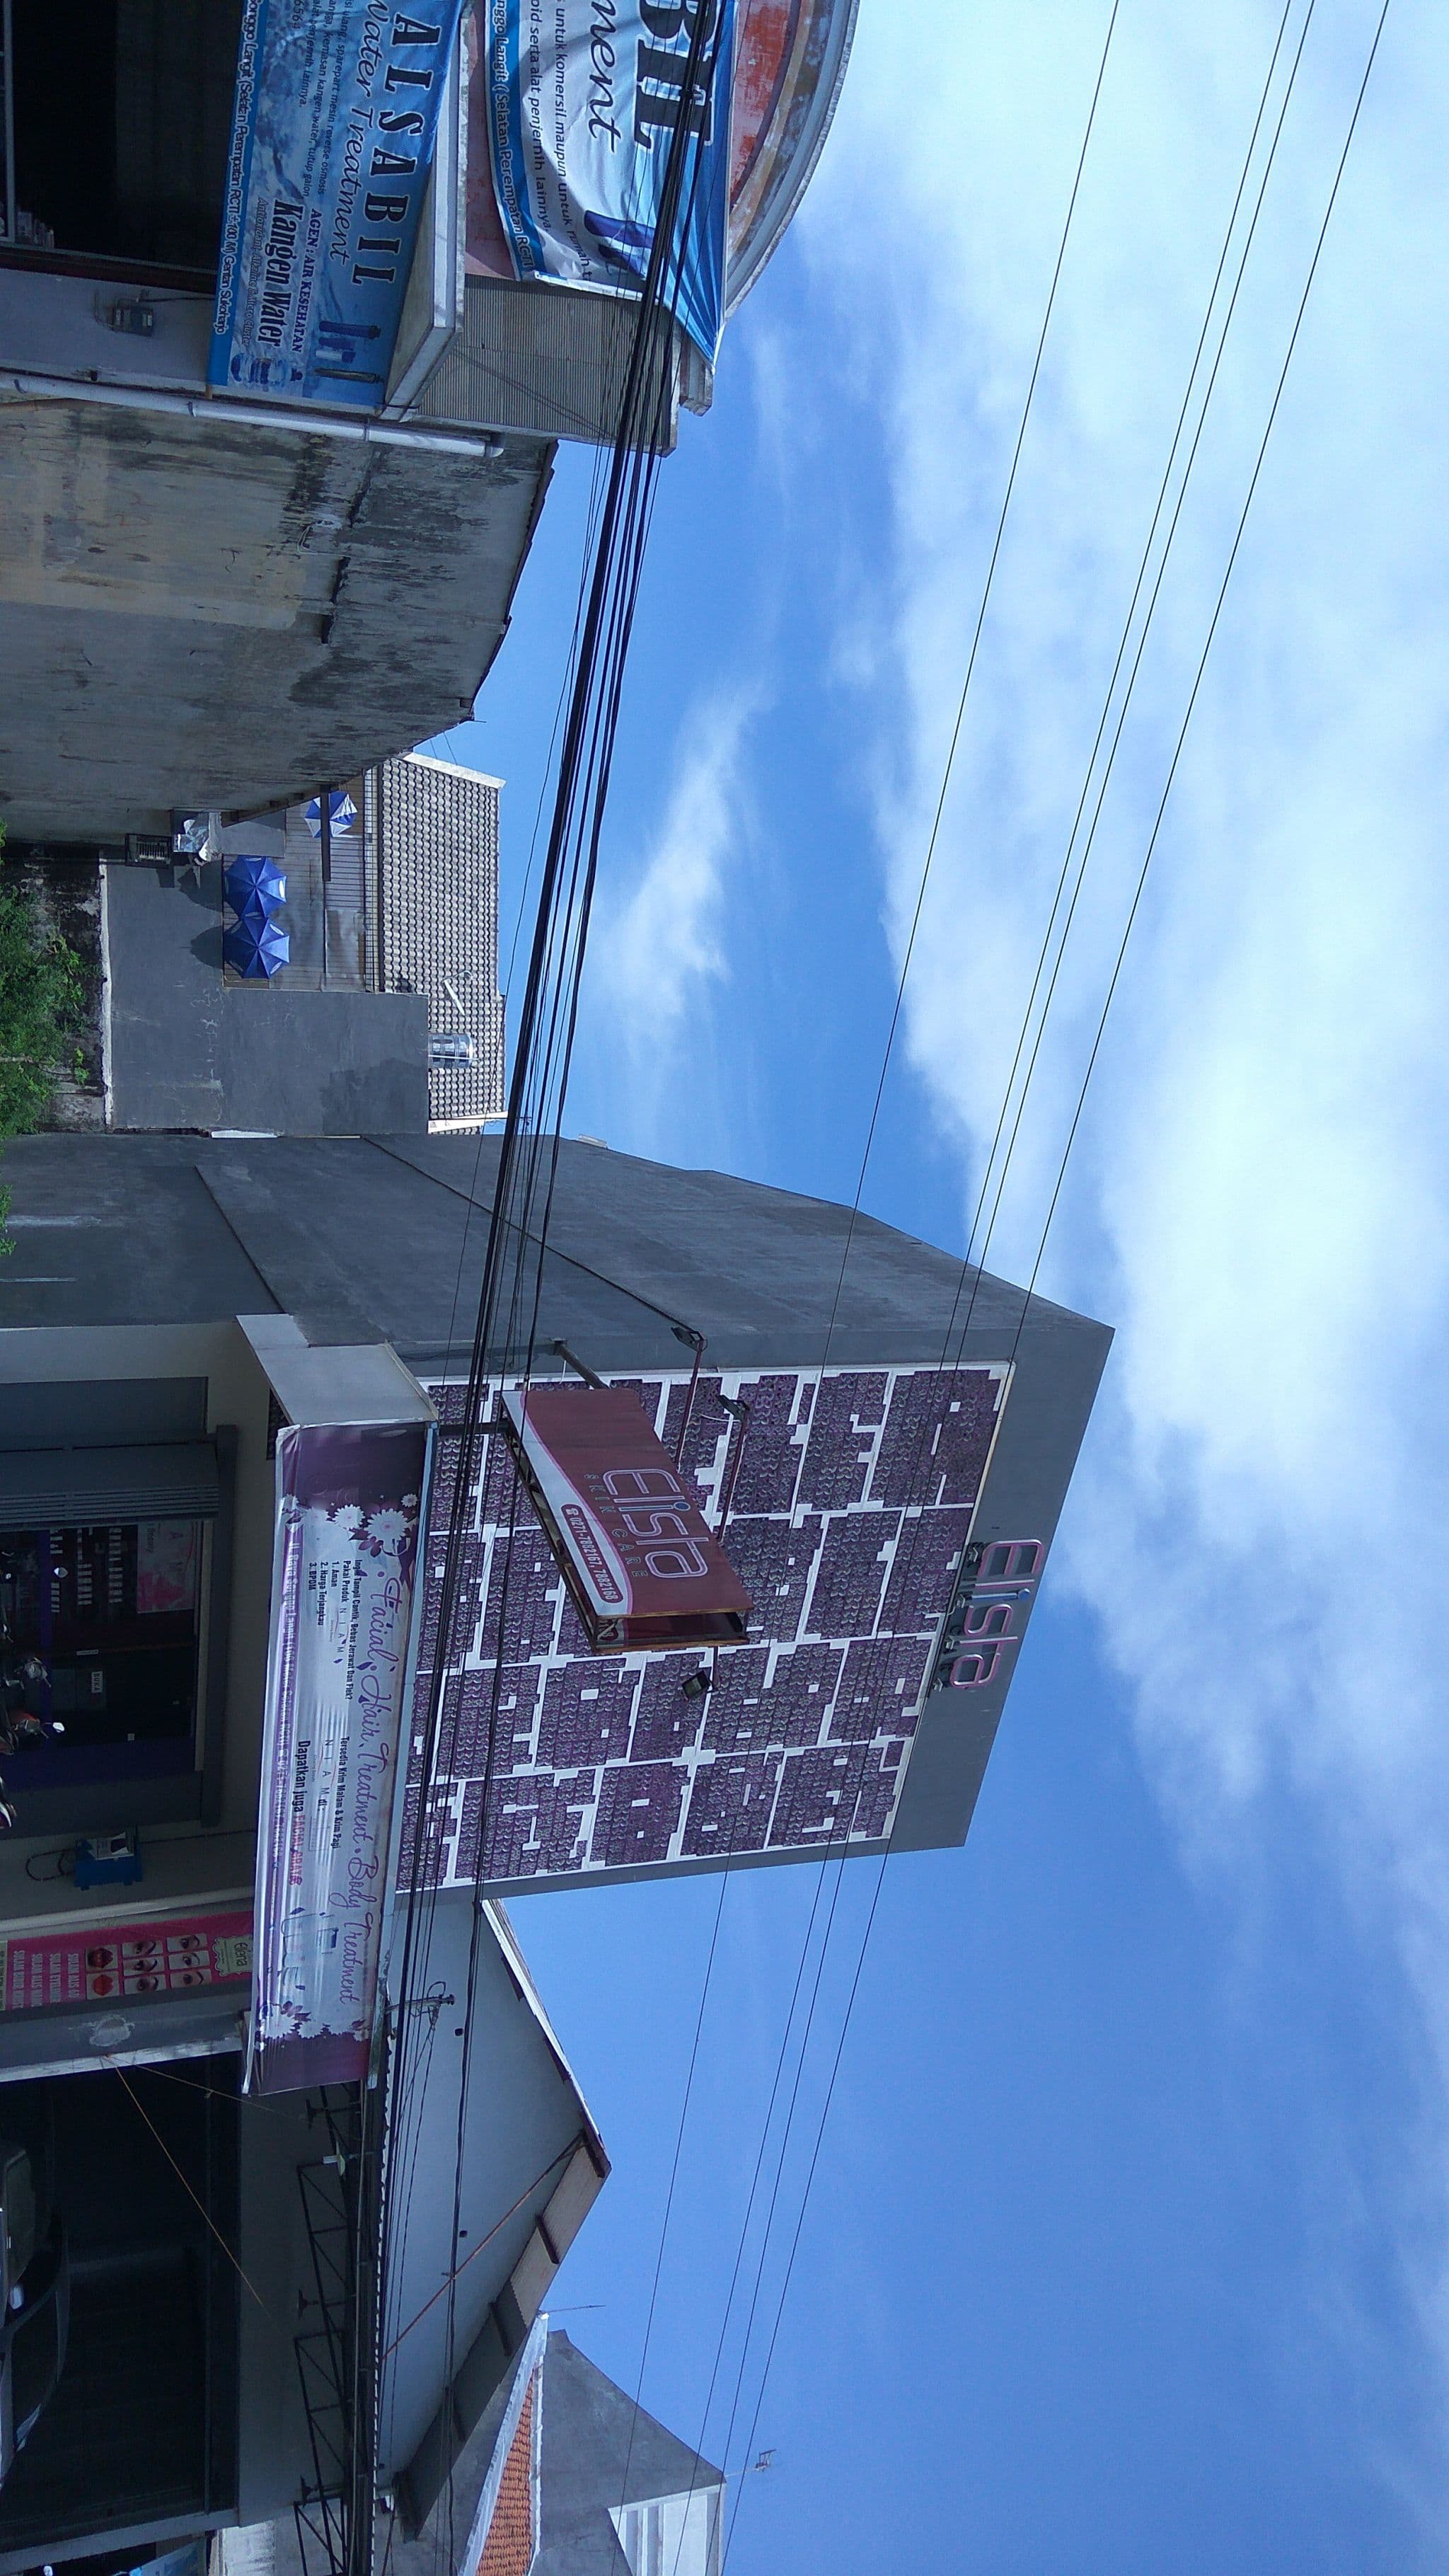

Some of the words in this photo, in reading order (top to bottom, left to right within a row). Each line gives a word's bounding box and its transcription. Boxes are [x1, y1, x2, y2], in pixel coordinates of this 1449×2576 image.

[529, 27, 541, 62] serta
[555, 8, 567, 50] untuk
[240, 44, 257, 78] Langit
[318, 33, 333, 76] kemasan
[331, 45, 346, 92] sparepart
[494, 38, 508, 81] Langit
[313, 79, 327, 117] kangen
[530, 67, 543, 93] alat
[555, 54, 568, 117] komersil
[327, 95, 339, 122] mesin
[496, 95, 509, 146] Selatan
[322, 125, 334, 159] reverse
[352, 13, 440, 284] ALSABIL
[528, 97, 545, 171] penjernih
[553, 121, 567, 177] maupun
[231, 126, 248, 186] Perempatan
[304, 147, 317, 172] tutup
[317, 161, 329, 195] osmosis
[329, 107, 374, 265] Treatment
[500, 150, 523, 232] Perempatan
[229, 189, 241, 213] RCTI
[536, 177, 551, 233] lainnya.
[558, 183, 572, 226] untuk
[265, 200, 304, 284] Kangen
[306, 209, 323, 248] AGEN
[301, 255, 316, 277] AIR
[516, 236, 533, 266] RCTI
[567, 231, 591, 266] rumah
[221, 255, 235, 288] Gentan
[214, 290, 231, 333] Sukoharjo
[258, 292, 292, 347] Water
[291, 280, 313, 353] KESEHATAN
[584, 1473, 616, 1513] SKIN
[611, 1529, 649, 1577] CARE
[602, 1468, 709, 1579] Elista
[308, 1570, 316, 1591] BPOM
[318, 1570, 328, 1589] Harga
[330, 1569, 339, 1587] Aman
[342, 1560, 351, 1579] Pakai
[351, 1577, 362, 1598] Tampil
[316, 1591, 327, 1626] Terjangkau
[340, 1580, 350, 1603] Produk
[350, 1599, 361, 1623] Cantik,
[366, 1577, 403, 1662] Facial
[949, 1539, 1044, 1689] Elista
[349, 1623, 359, 1643] Bebas
[347, 1644, 357, 1669] Jerawat
[345, 1684, 354, 1700] Flek?
[346, 1670, 356, 1682] Dan
[359, 1674, 393, 1744] Hair
[294, 1740, 311, 1788] Dapatkan
[338, 1736, 350, 1766] Tersedia
[337, 1767, 347, 1783] Krim
[351, 1742, 388, 1844] Treatment
[292, 1790, 307, 1812] juga
[335, 1785, 346, 1808] Malam
[330, 1834, 342, 1849] Pagi
[328, 1855, 380, 1910] Body
[337, 1911, 374, 2005] Treatment
